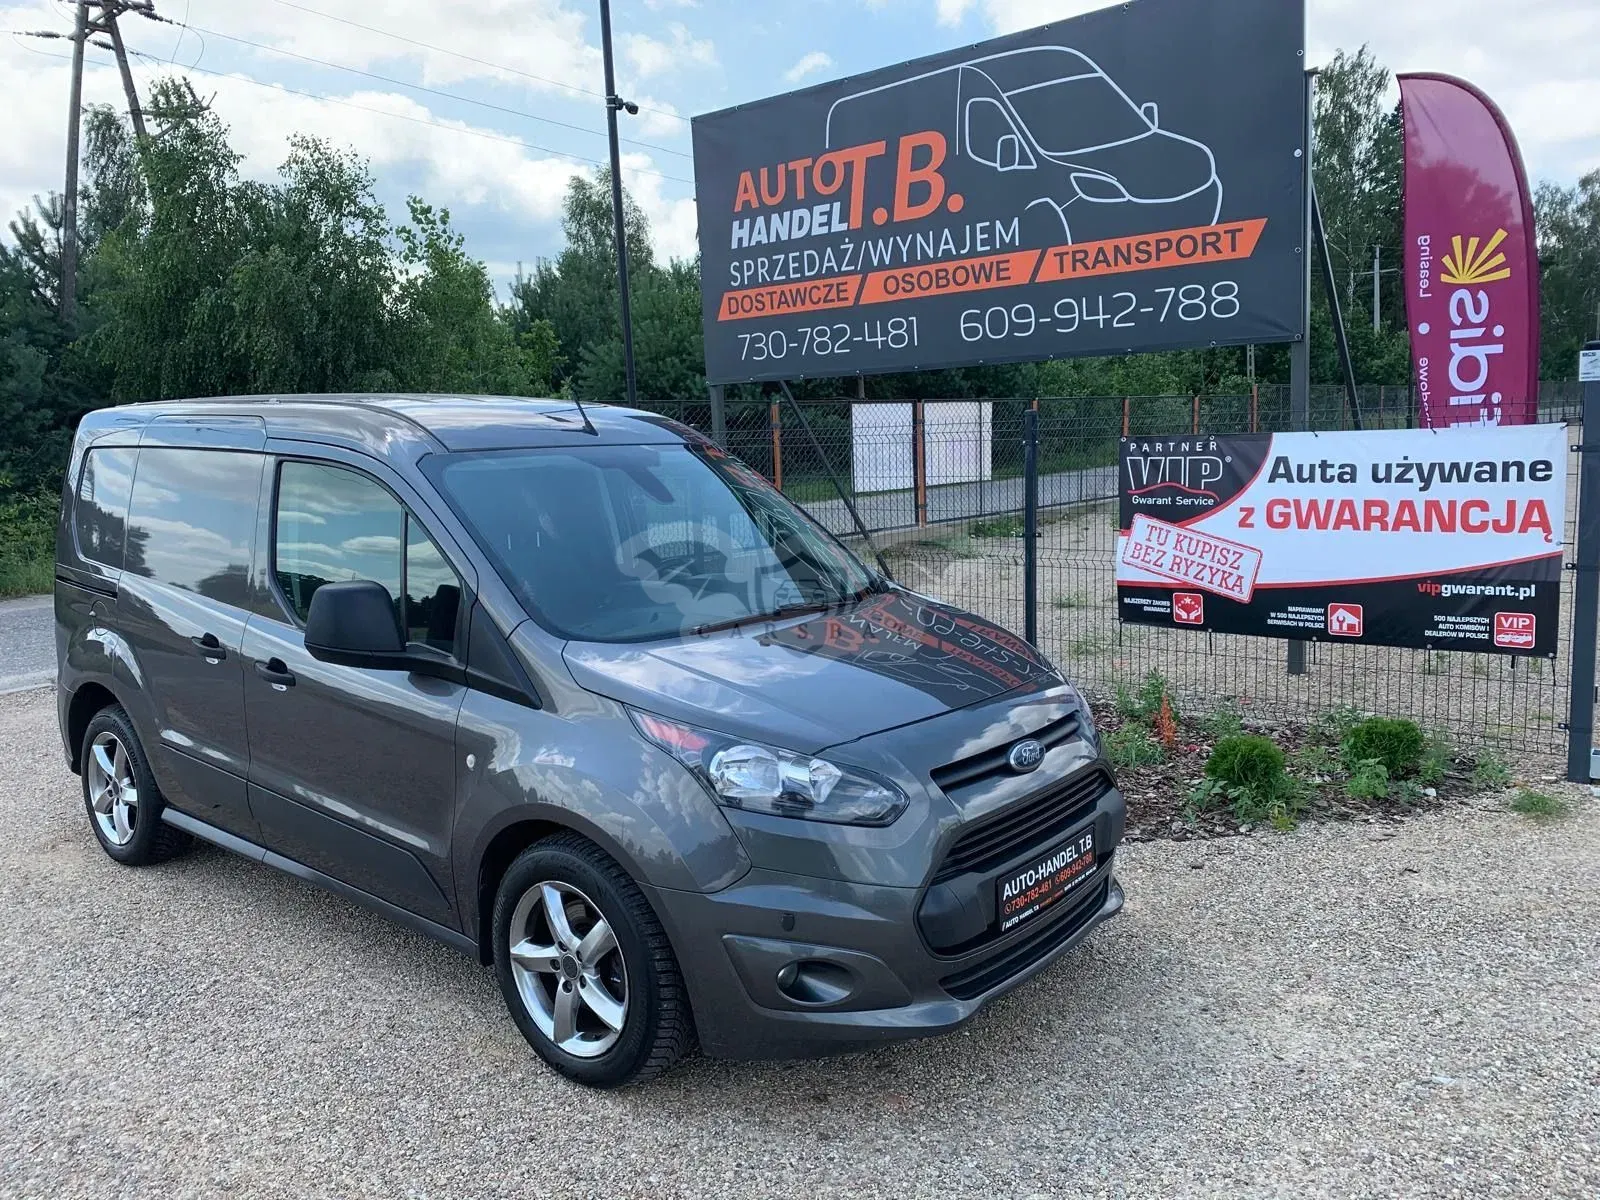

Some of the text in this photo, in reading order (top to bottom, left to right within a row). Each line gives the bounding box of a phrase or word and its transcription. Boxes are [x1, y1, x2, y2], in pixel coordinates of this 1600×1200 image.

[733, 152, 845, 213] AUTO
[731, 201, 848, 250] HANDEL
[727, 228, 1244, 316] DOSTAWCZE OSOBOWE TRANSPORT
[960, 281, 1240, 342] 609-942-788
[737, 316, 919, 361] 730-782-481
[1130, 441, 1217, 452] PARTNER
[1267, 455, 1553, 492] Auta używane
[1131, 495, 1214, 506] Gwarant Service
[1238, 498, 1553, 543] z GWARANCJĄ
[1145, 523, 1245, 571] TU KUPISZ
[1129, 542, 1246, 595] BEZ RYZYKA
[1417, 581, 1536, 600] vipgwarant.pl
[1287, 613, 1325, 621] NAJLEPSZYCH
[1424, 629, 1458, 638] DEALERÓW
[1465, 632, 1489, 640] POLSCE
[1446, 615, 1490, 624] NAJLEPSZYCH
[1455, 623, 1487, 632] KOMISÓW
[1500, 616, 1531, 629] VIP
[1021, 742, 1041, 765] Ford
[1002, 845, 1079, 902] AUTO-HANDEL
[1078, 834, 1093, 854] T.B
[1011, 879, 1052, 912] 730-782-481
